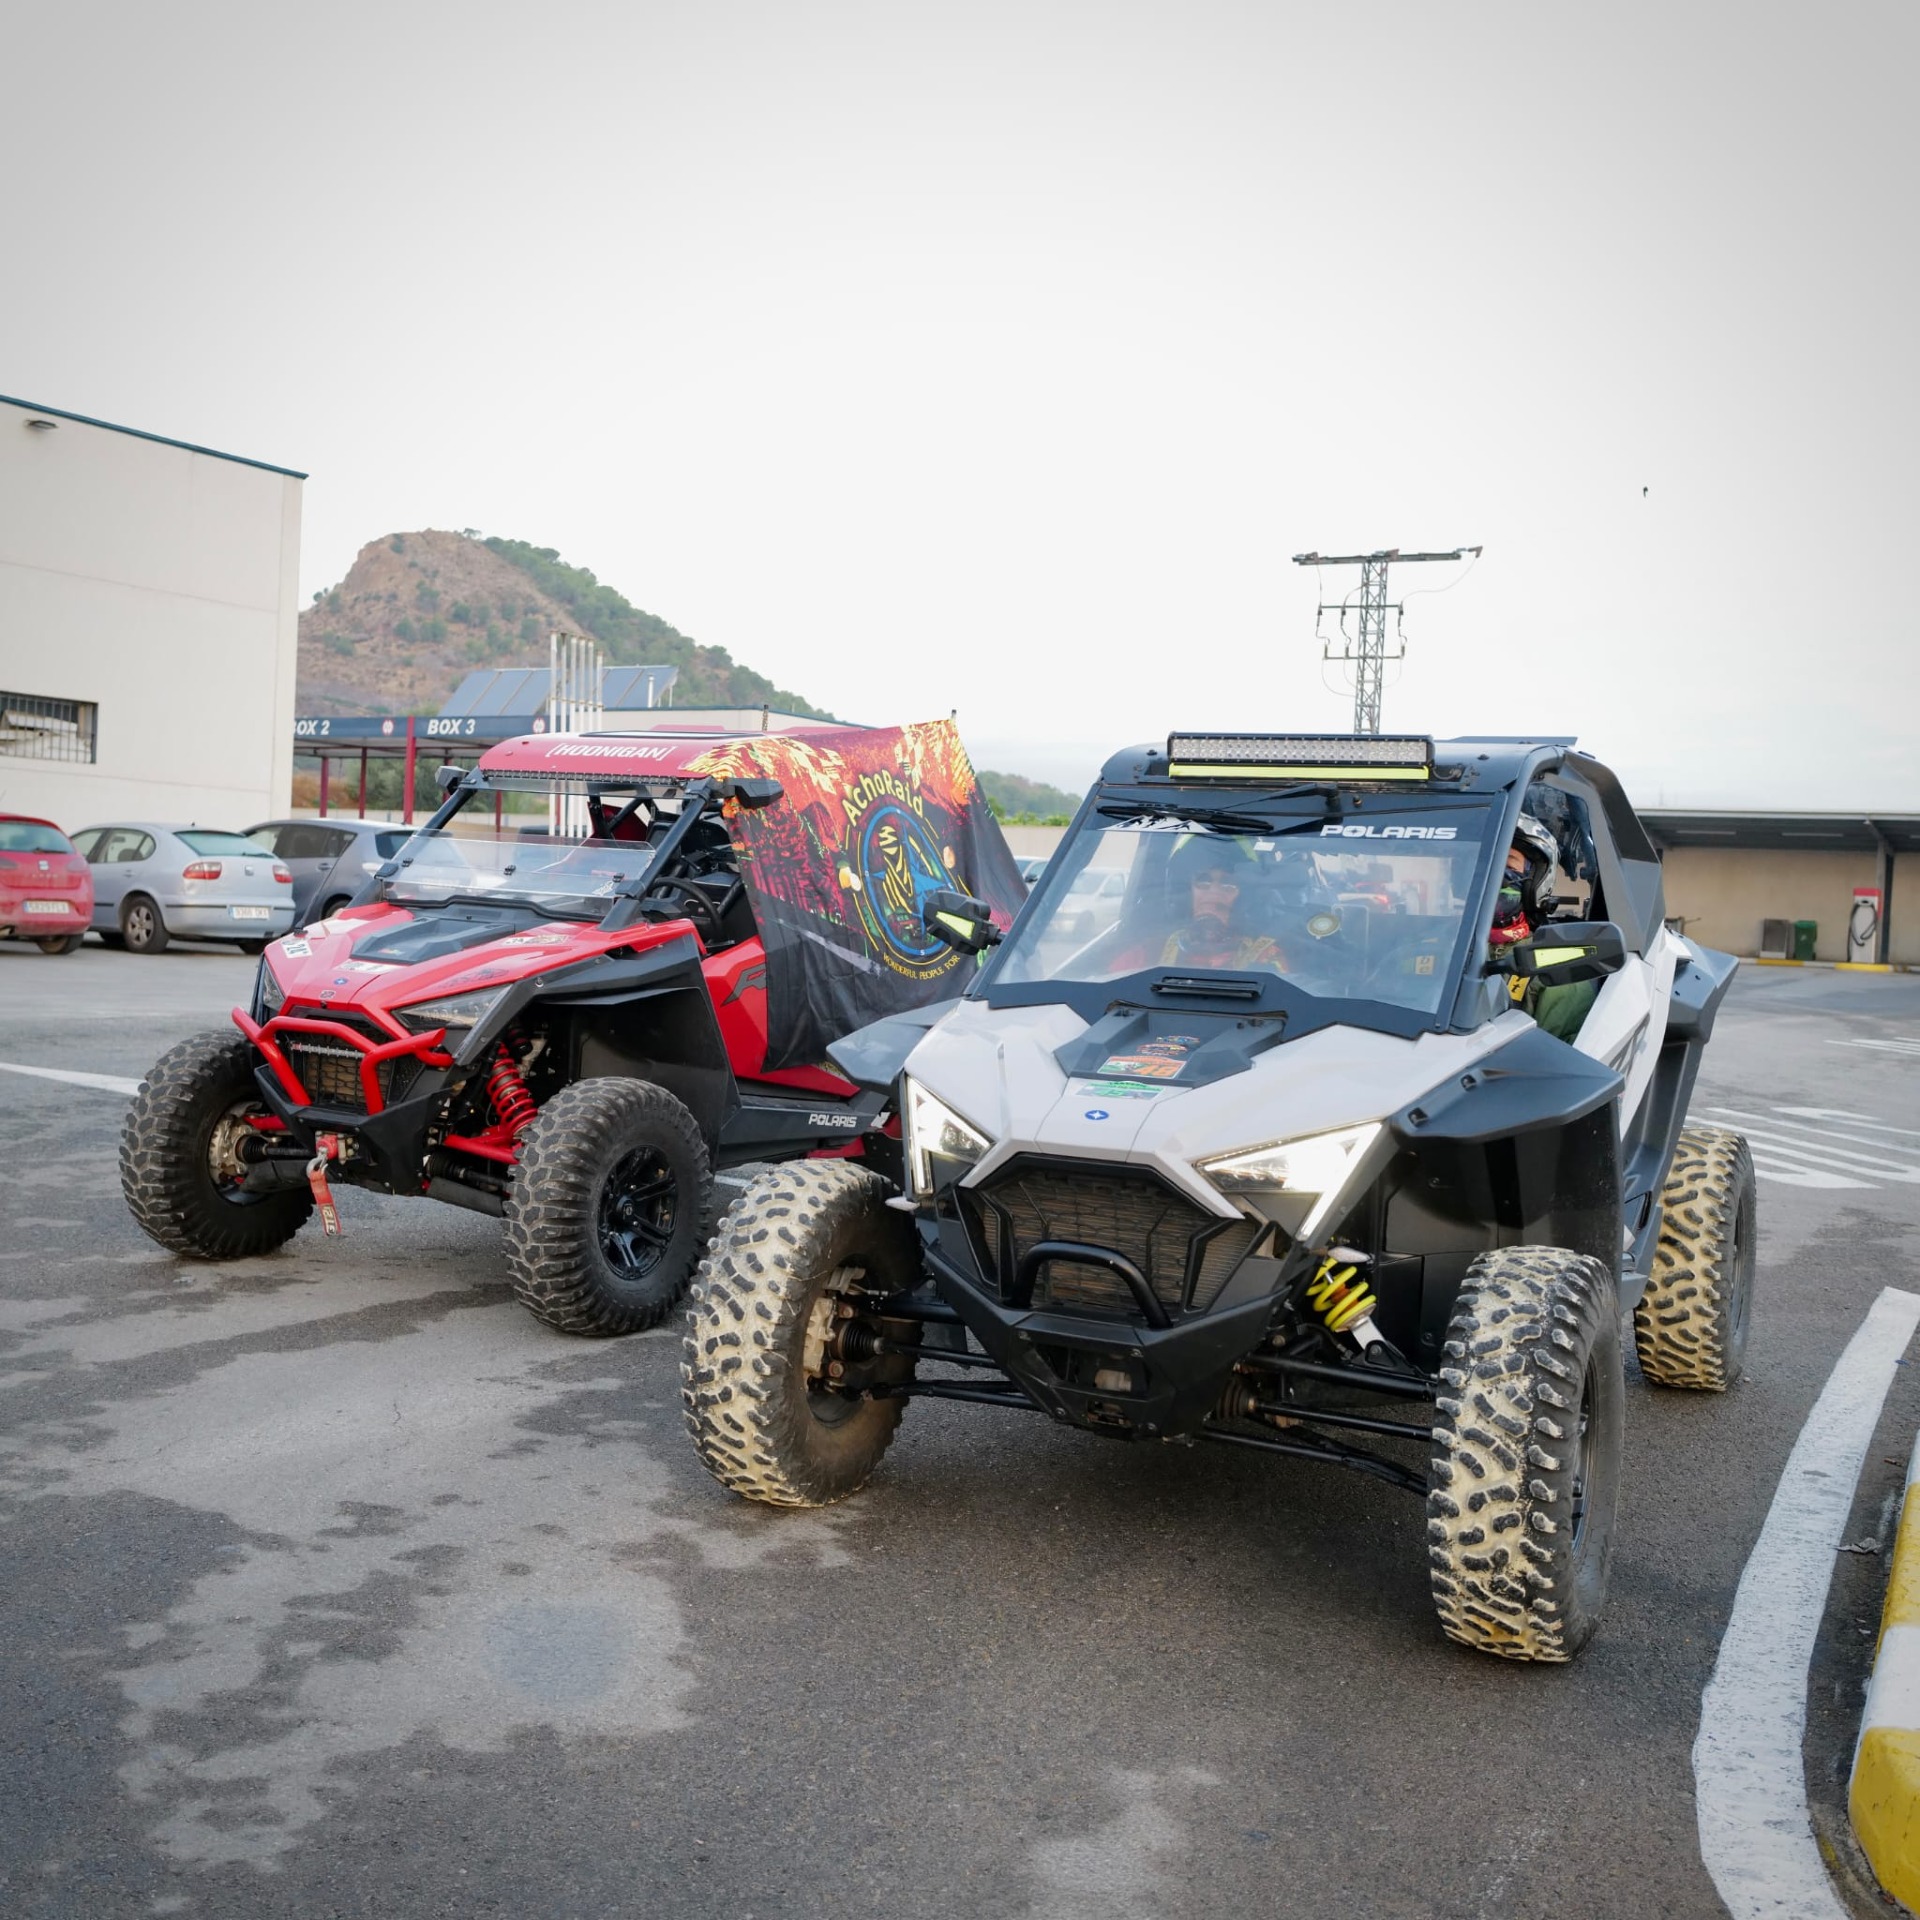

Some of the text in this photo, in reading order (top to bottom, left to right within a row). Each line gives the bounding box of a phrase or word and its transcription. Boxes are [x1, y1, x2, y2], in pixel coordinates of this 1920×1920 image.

[295, 719, 331, 735] OX 2
[426, 718, 477, 735] BOX 3
[1320, 824, 1458, 840] POLARIS
[883, 951, 960, 980] WONDERFUL PEOPLE FOR
[808, 1113, 858, 1128] POLARIS
